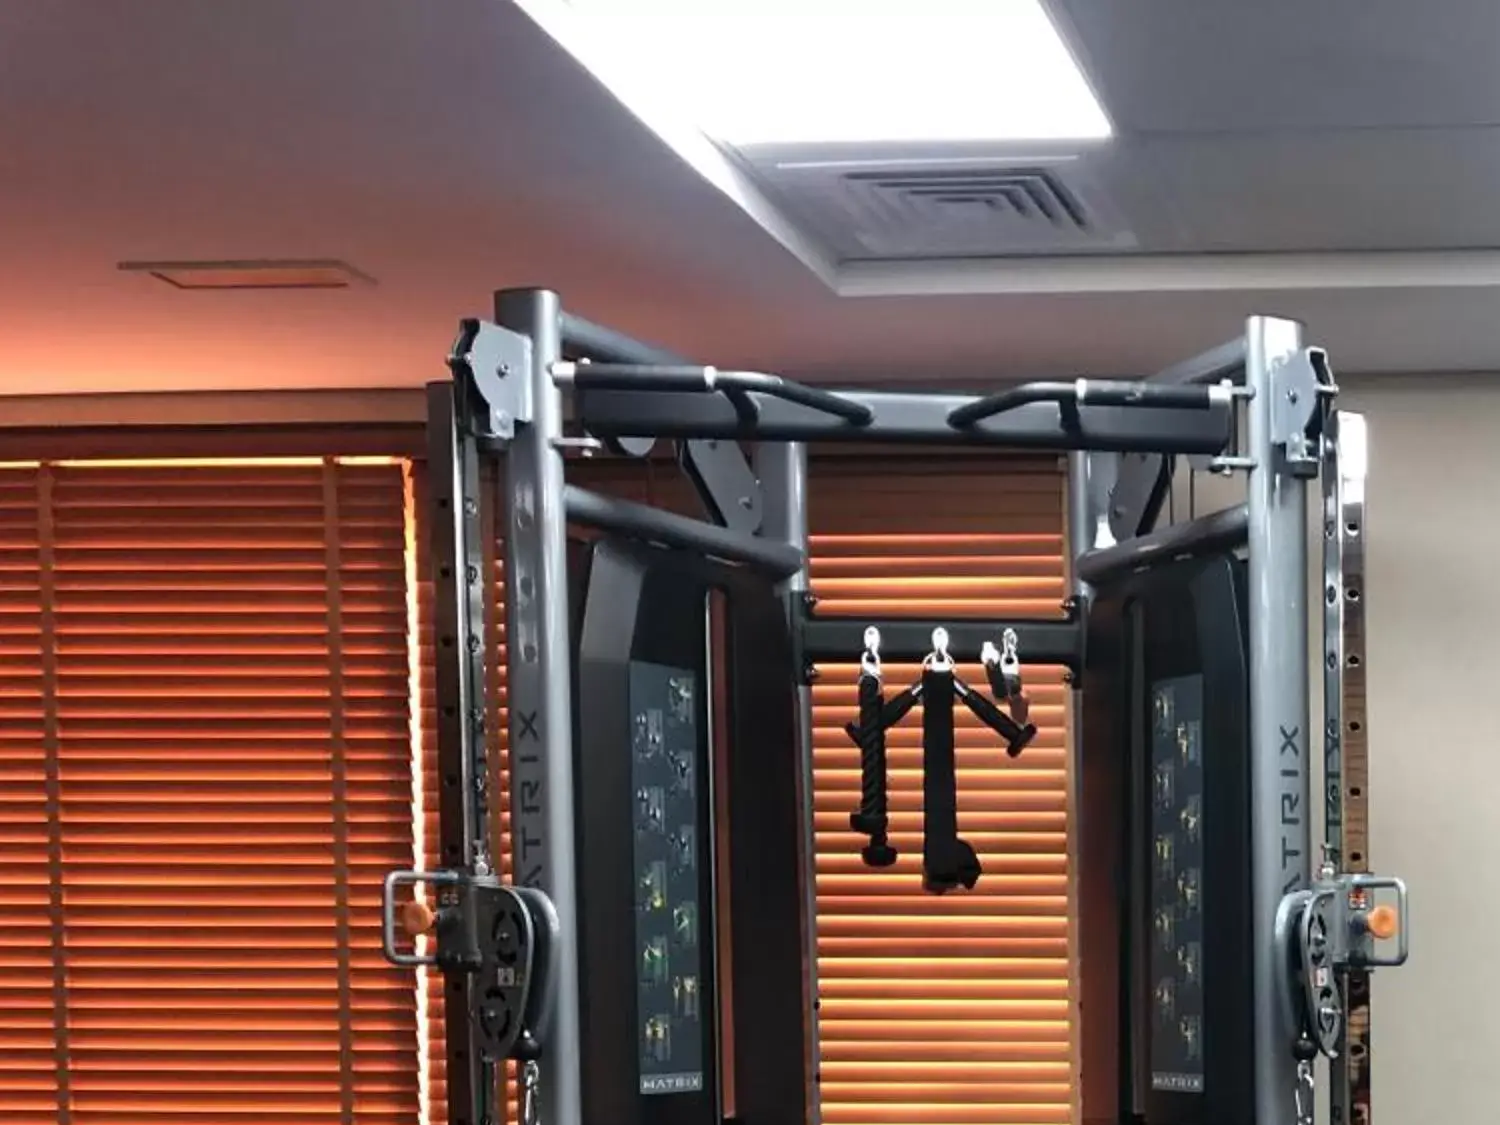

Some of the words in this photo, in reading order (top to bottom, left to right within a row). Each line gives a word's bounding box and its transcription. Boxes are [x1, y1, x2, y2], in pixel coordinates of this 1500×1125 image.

[517, 710, 543, 888] ATRIX
[1279, 725, 1301, 895] ATRIX
[643, 1077, 700, 1089] MATRIX
